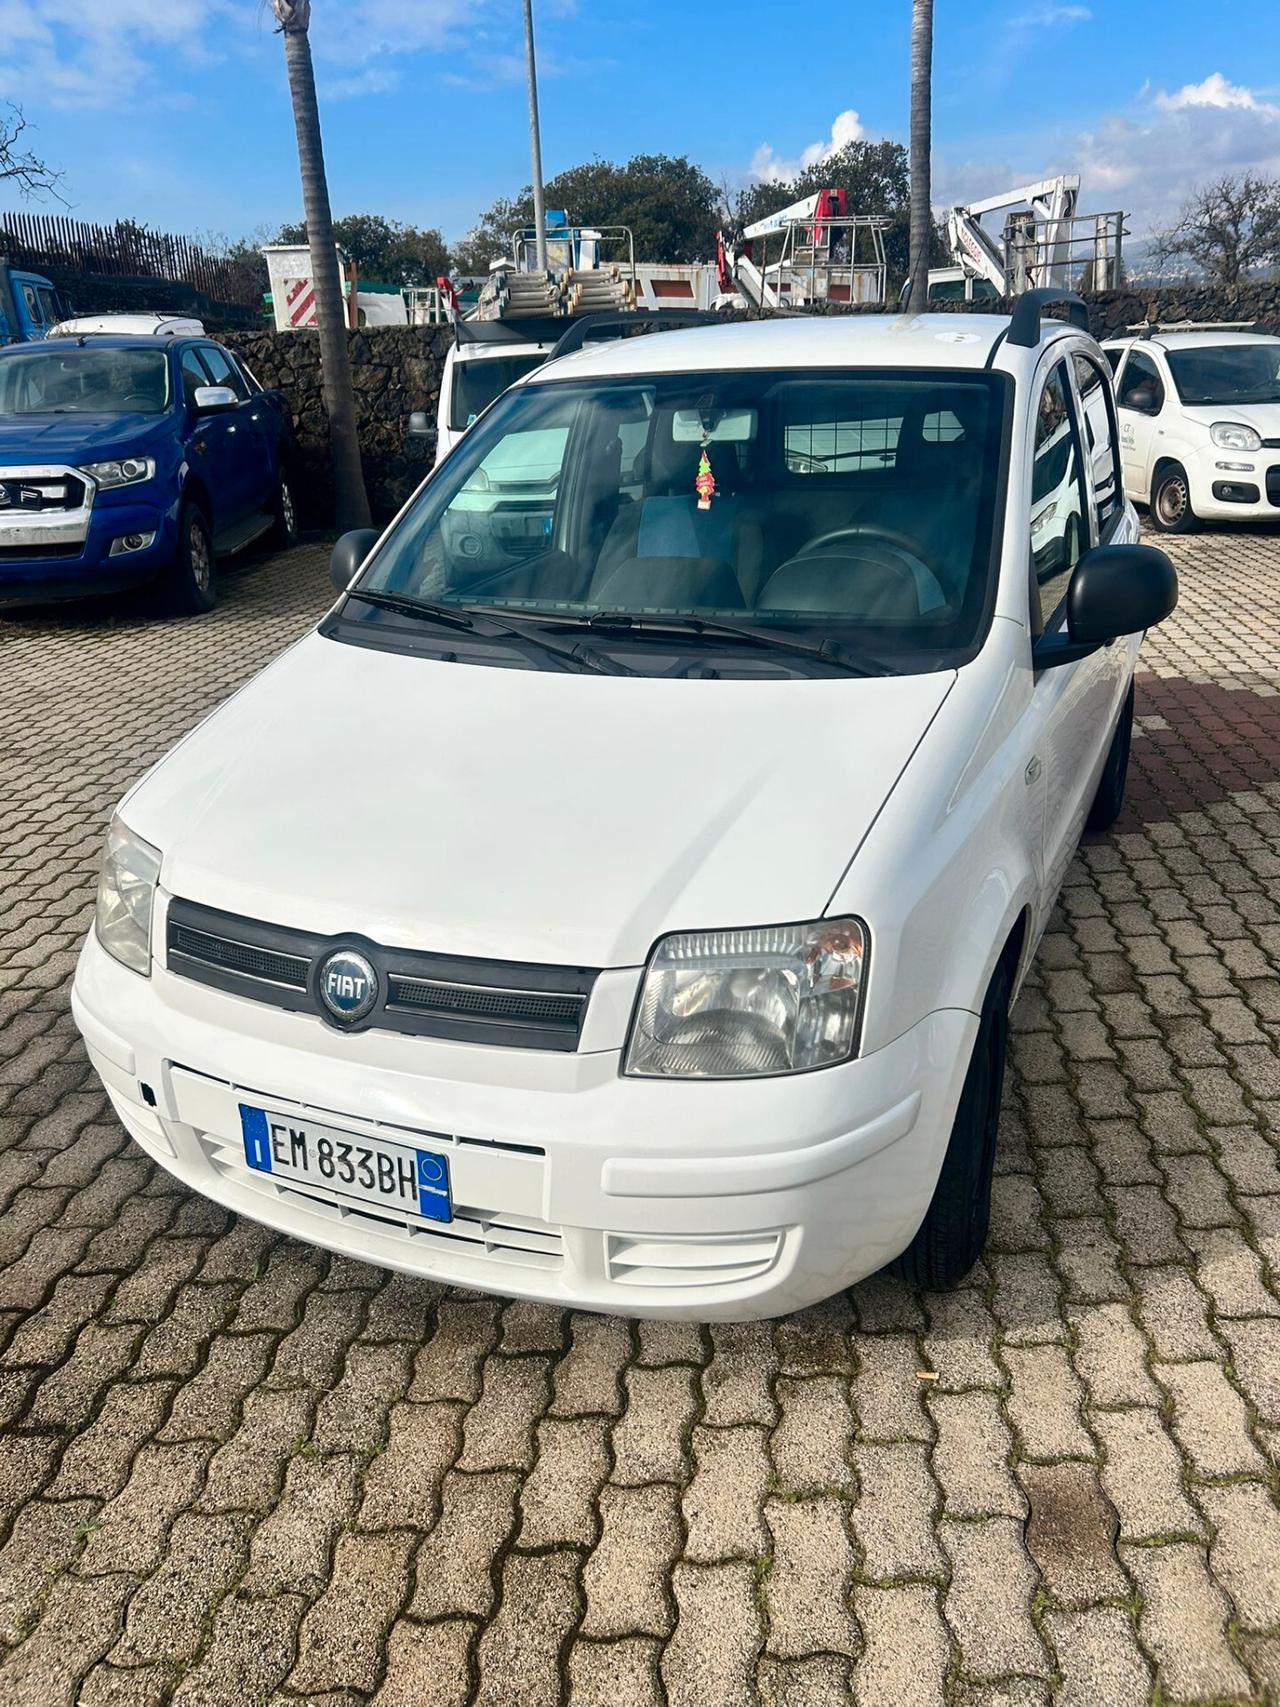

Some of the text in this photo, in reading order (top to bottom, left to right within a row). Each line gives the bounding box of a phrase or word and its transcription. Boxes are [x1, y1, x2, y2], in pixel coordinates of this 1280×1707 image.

[327, 972, 366, 999] FIAT
[270, 1122, 418, 1201] EM 833BH
